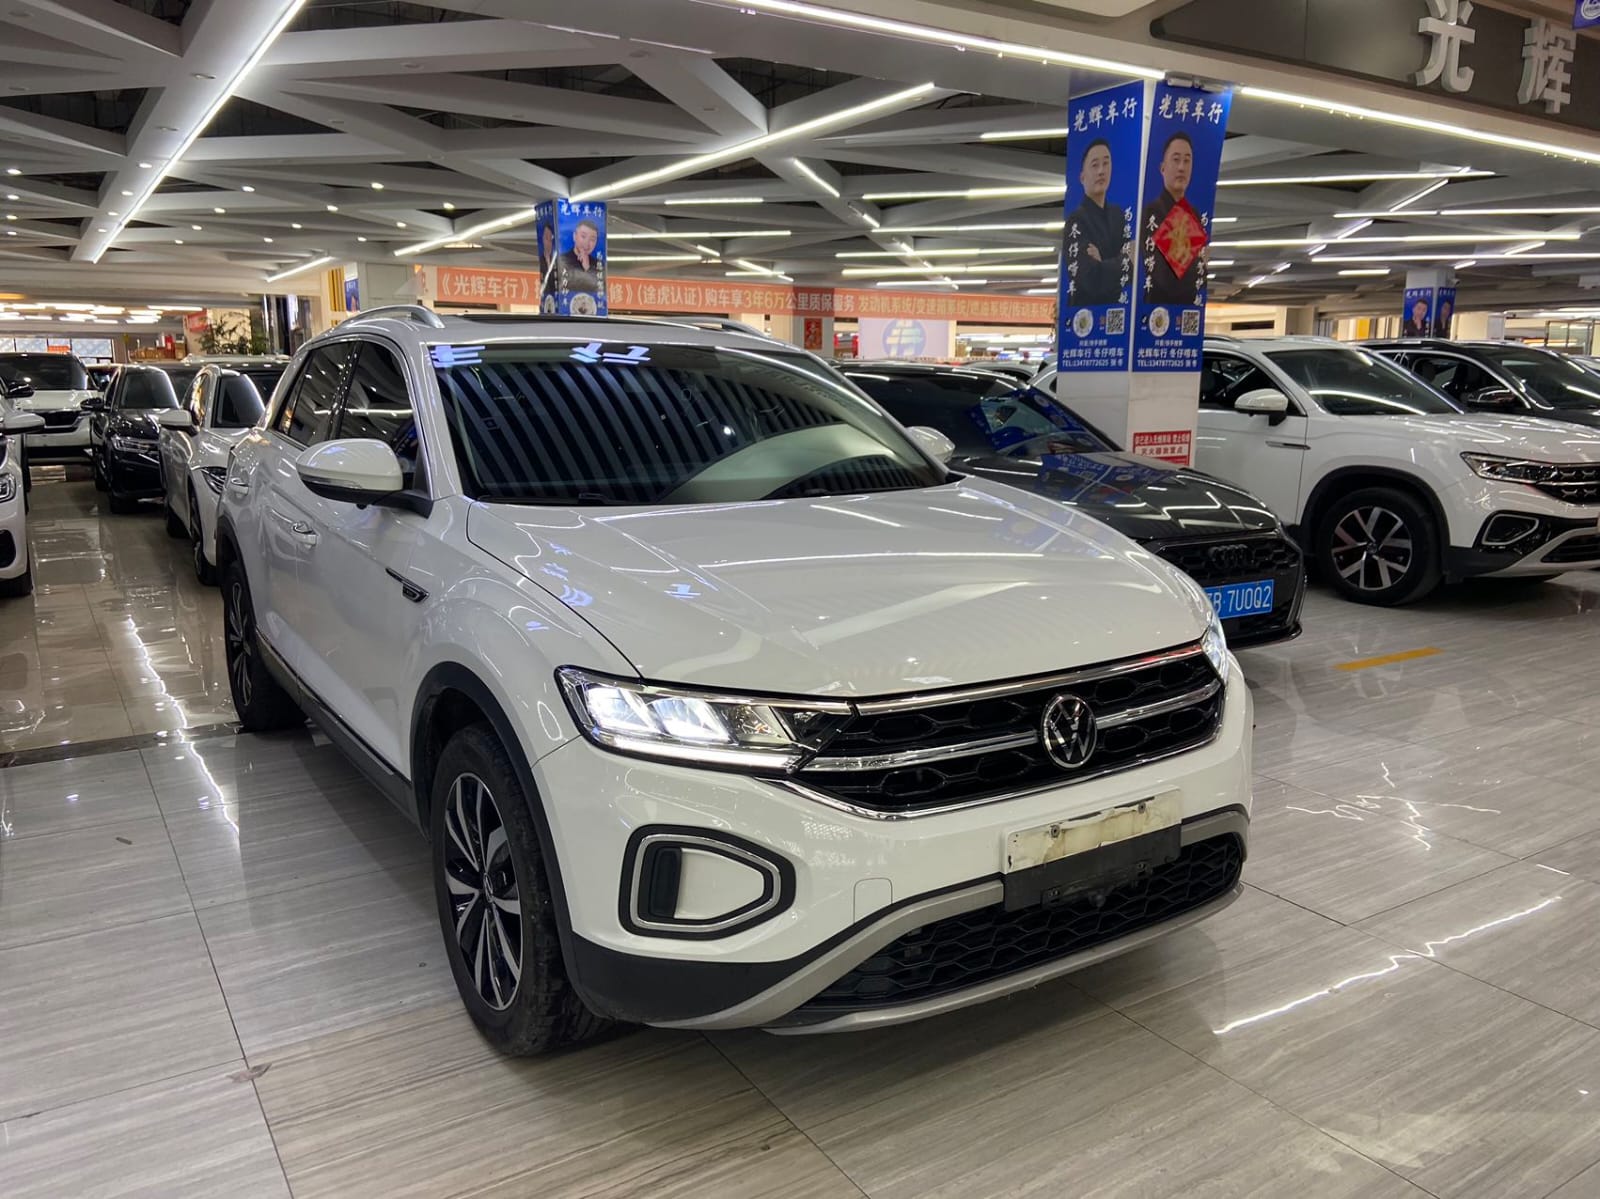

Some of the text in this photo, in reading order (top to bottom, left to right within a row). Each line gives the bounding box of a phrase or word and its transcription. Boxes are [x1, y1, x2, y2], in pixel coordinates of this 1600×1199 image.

[1073, 97, 1138, 132] 光辉车行
[1158, 93, 1224, 125] 光辉车行
